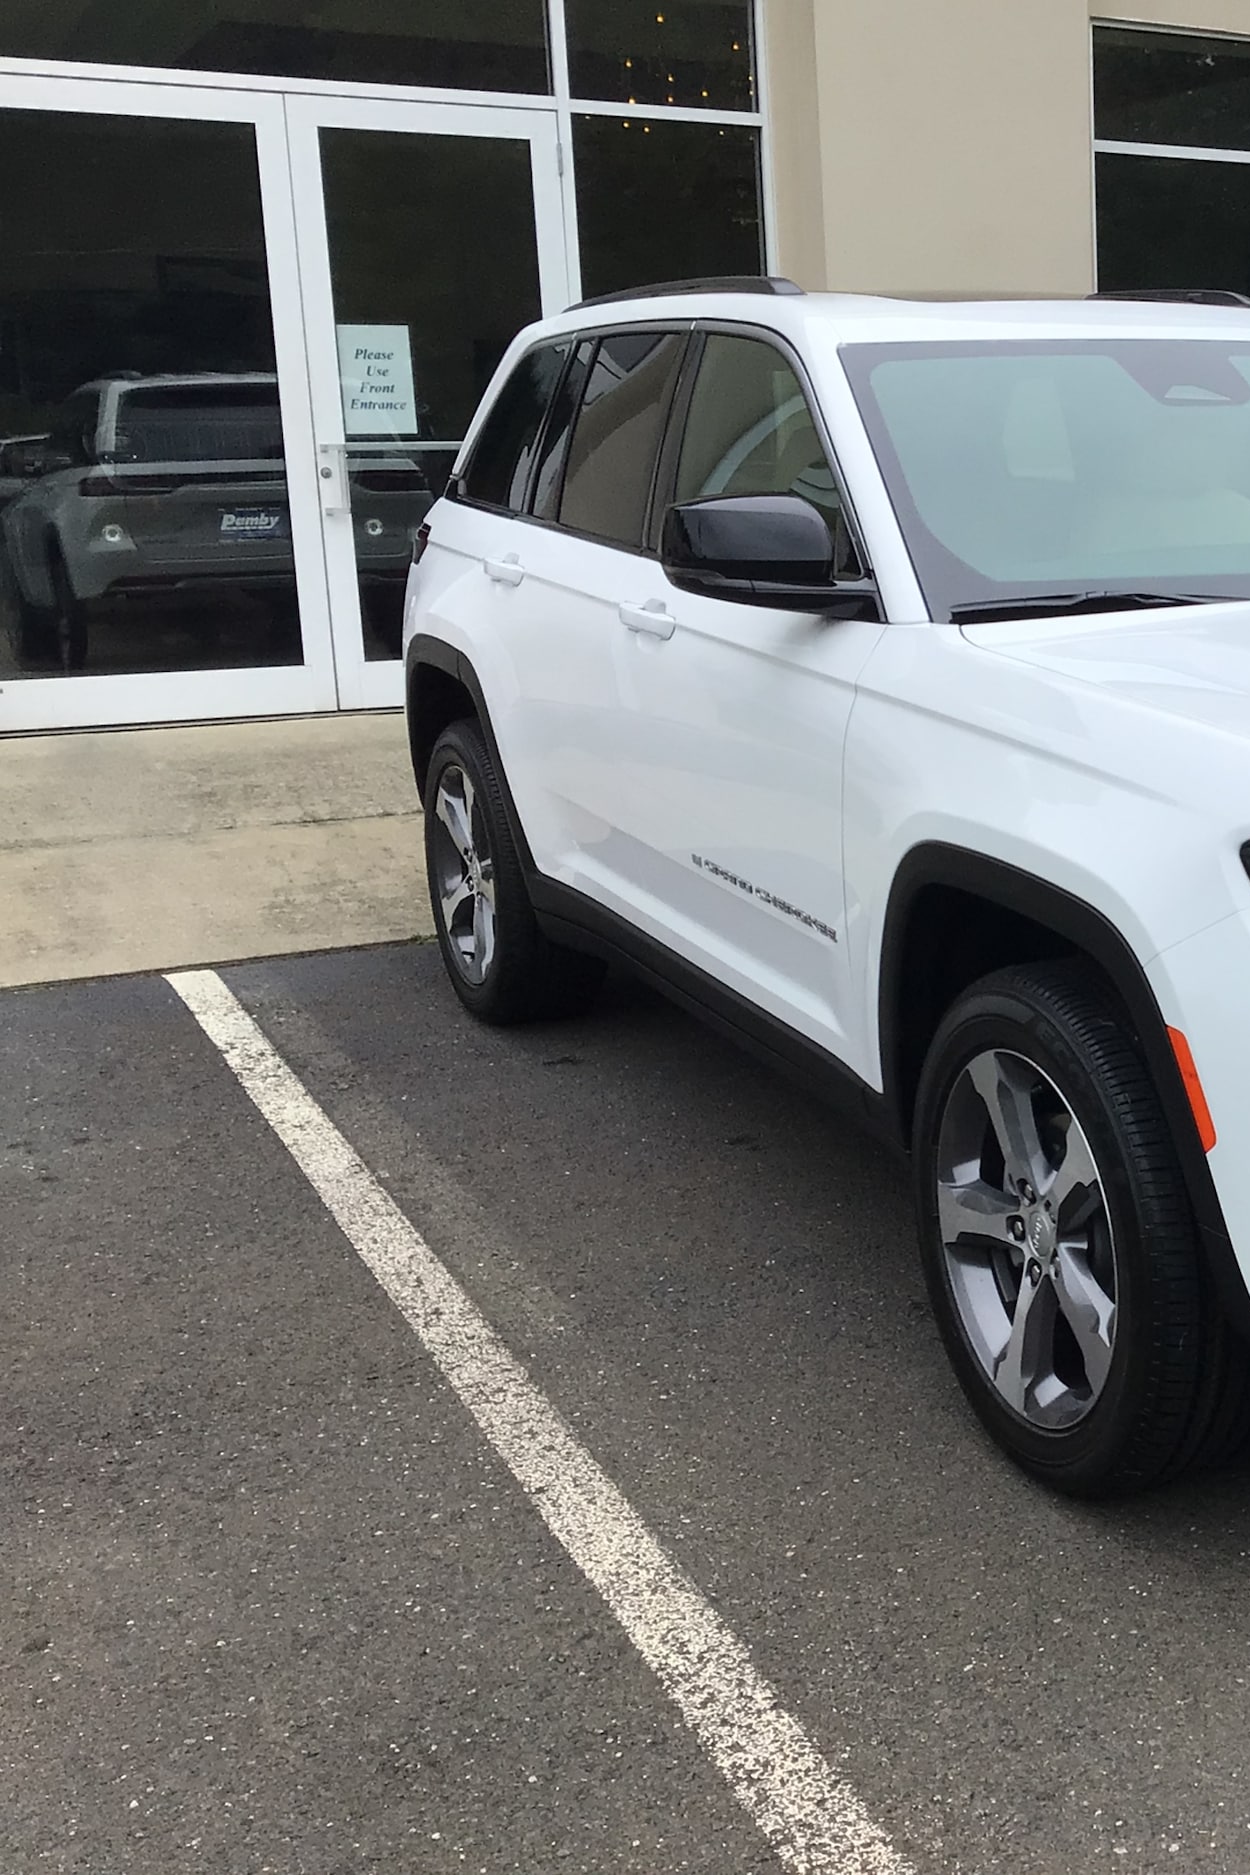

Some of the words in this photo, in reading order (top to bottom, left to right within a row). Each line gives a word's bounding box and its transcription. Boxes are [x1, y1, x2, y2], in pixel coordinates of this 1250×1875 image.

[354, 348, 394, 360] Please
[366, 365, 389, 377] Use
[360, 381, 395, 393] Front
[350, 398, 407, 410] Entrance
[220, 512, 280, 531] Pamby
